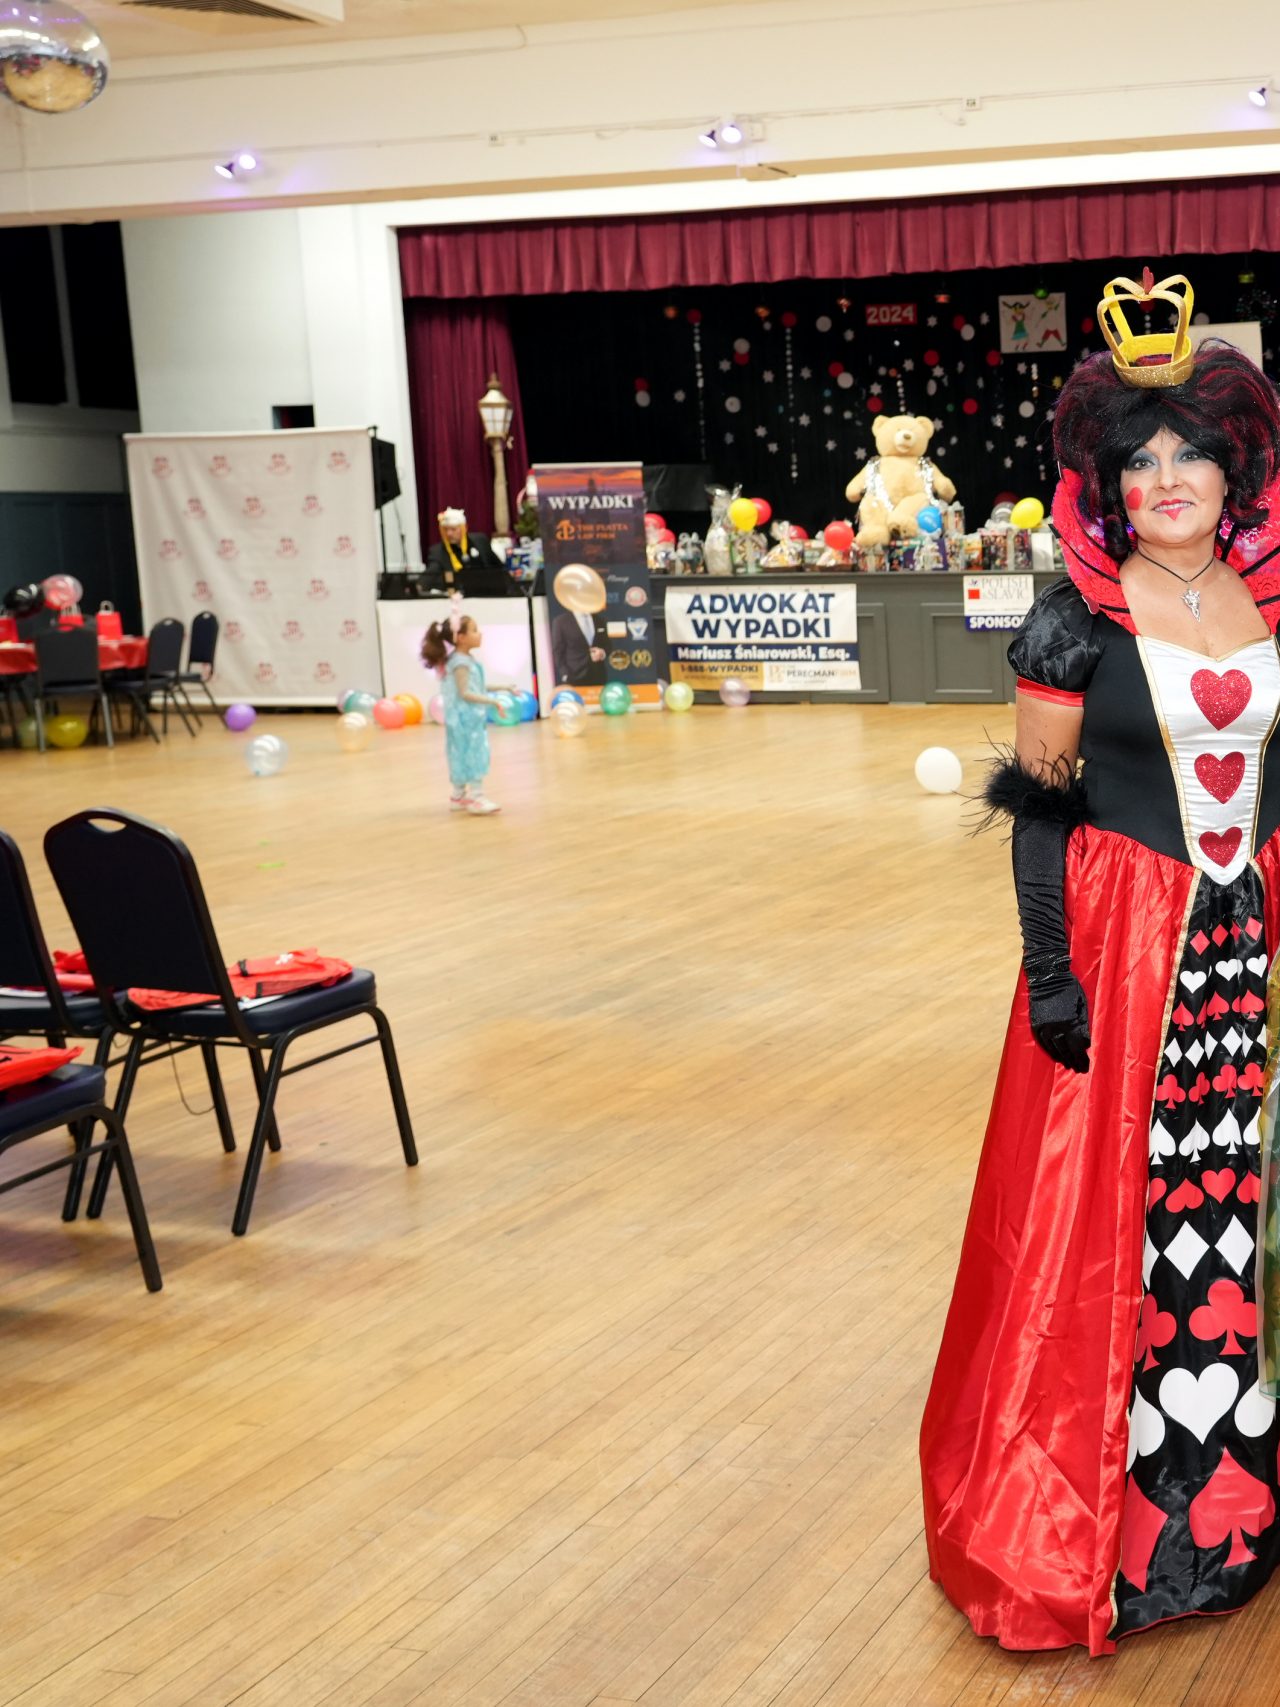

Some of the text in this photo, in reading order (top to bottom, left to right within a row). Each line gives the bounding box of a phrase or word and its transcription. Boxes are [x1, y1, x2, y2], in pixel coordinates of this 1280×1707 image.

[866, 304, 914, 324] 2024
[548, 495, 634, 510] WYPADKI
[982, 577, 1028, 589] POLISH
[988, 588, 1029, 600] SLAVIC
[687, 593, 835, 614] ADWOKAT
[691, 618, 830, 638] WYPADKI
[677, 644, 850, 661] Mariusz Śniarowski, Esq.
